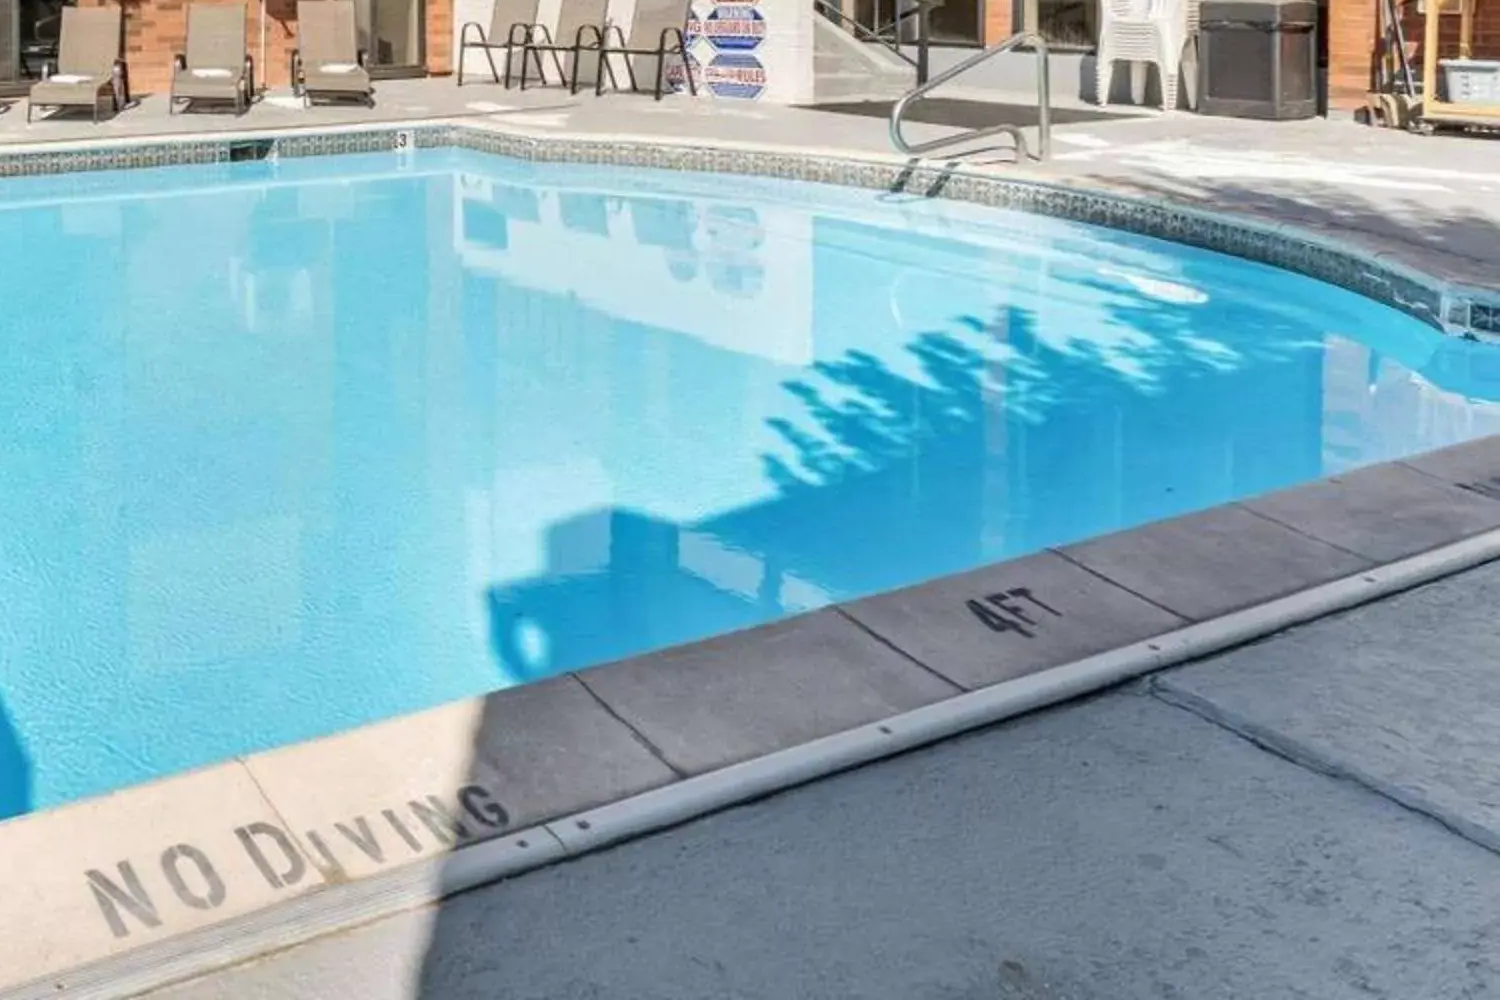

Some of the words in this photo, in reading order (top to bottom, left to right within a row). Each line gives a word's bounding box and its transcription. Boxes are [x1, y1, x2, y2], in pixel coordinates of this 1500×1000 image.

[965, 587, 1062, 638] 4FT
[84, 843, 227, 937] NO
[234, 784, 510, 889] DIVING
